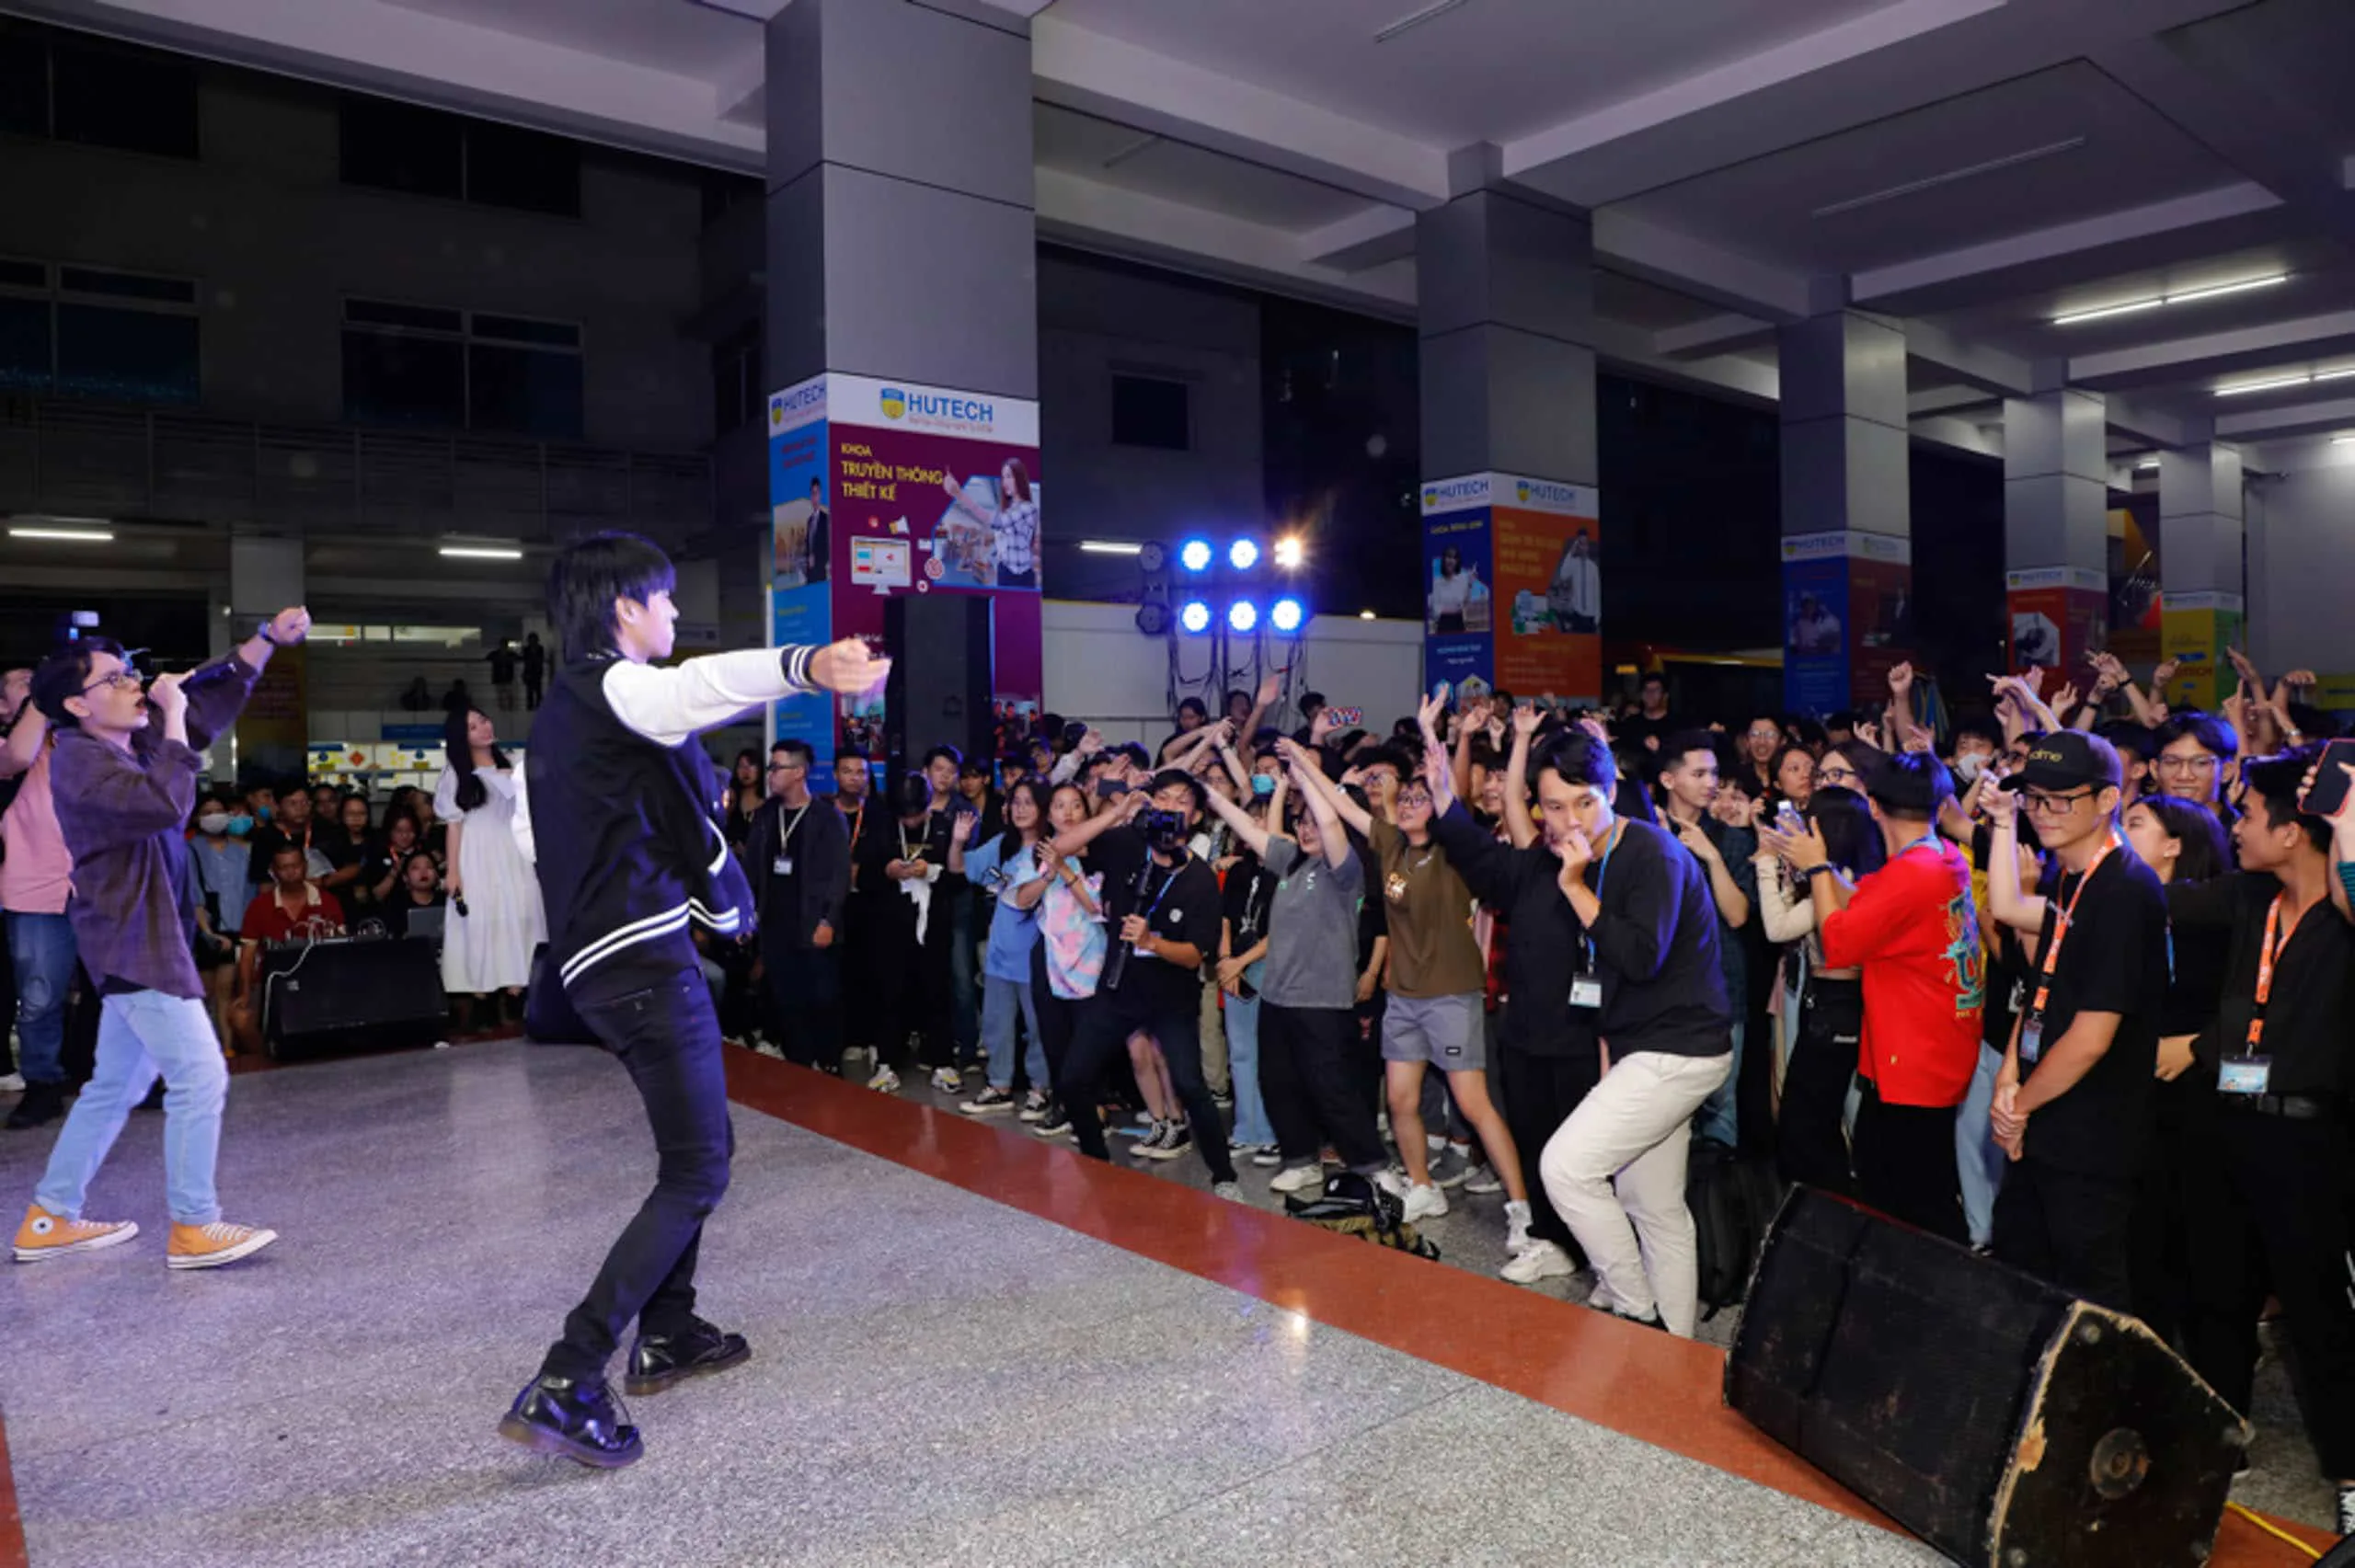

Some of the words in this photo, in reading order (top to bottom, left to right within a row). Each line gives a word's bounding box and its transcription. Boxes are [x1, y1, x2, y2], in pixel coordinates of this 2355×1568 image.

[784, 384, 825, 411] HUTECH
[909, 393, 994, 424] HUTECH
[841, 442, 873, 457] KHOA
[841, 459, 892, 479] TRUYỀN
[896, 464, 944, 486] THÔNG
[1440, 479, 1489, 498] HUTECH
[1531, 484, 1576, 502] HUTECH
